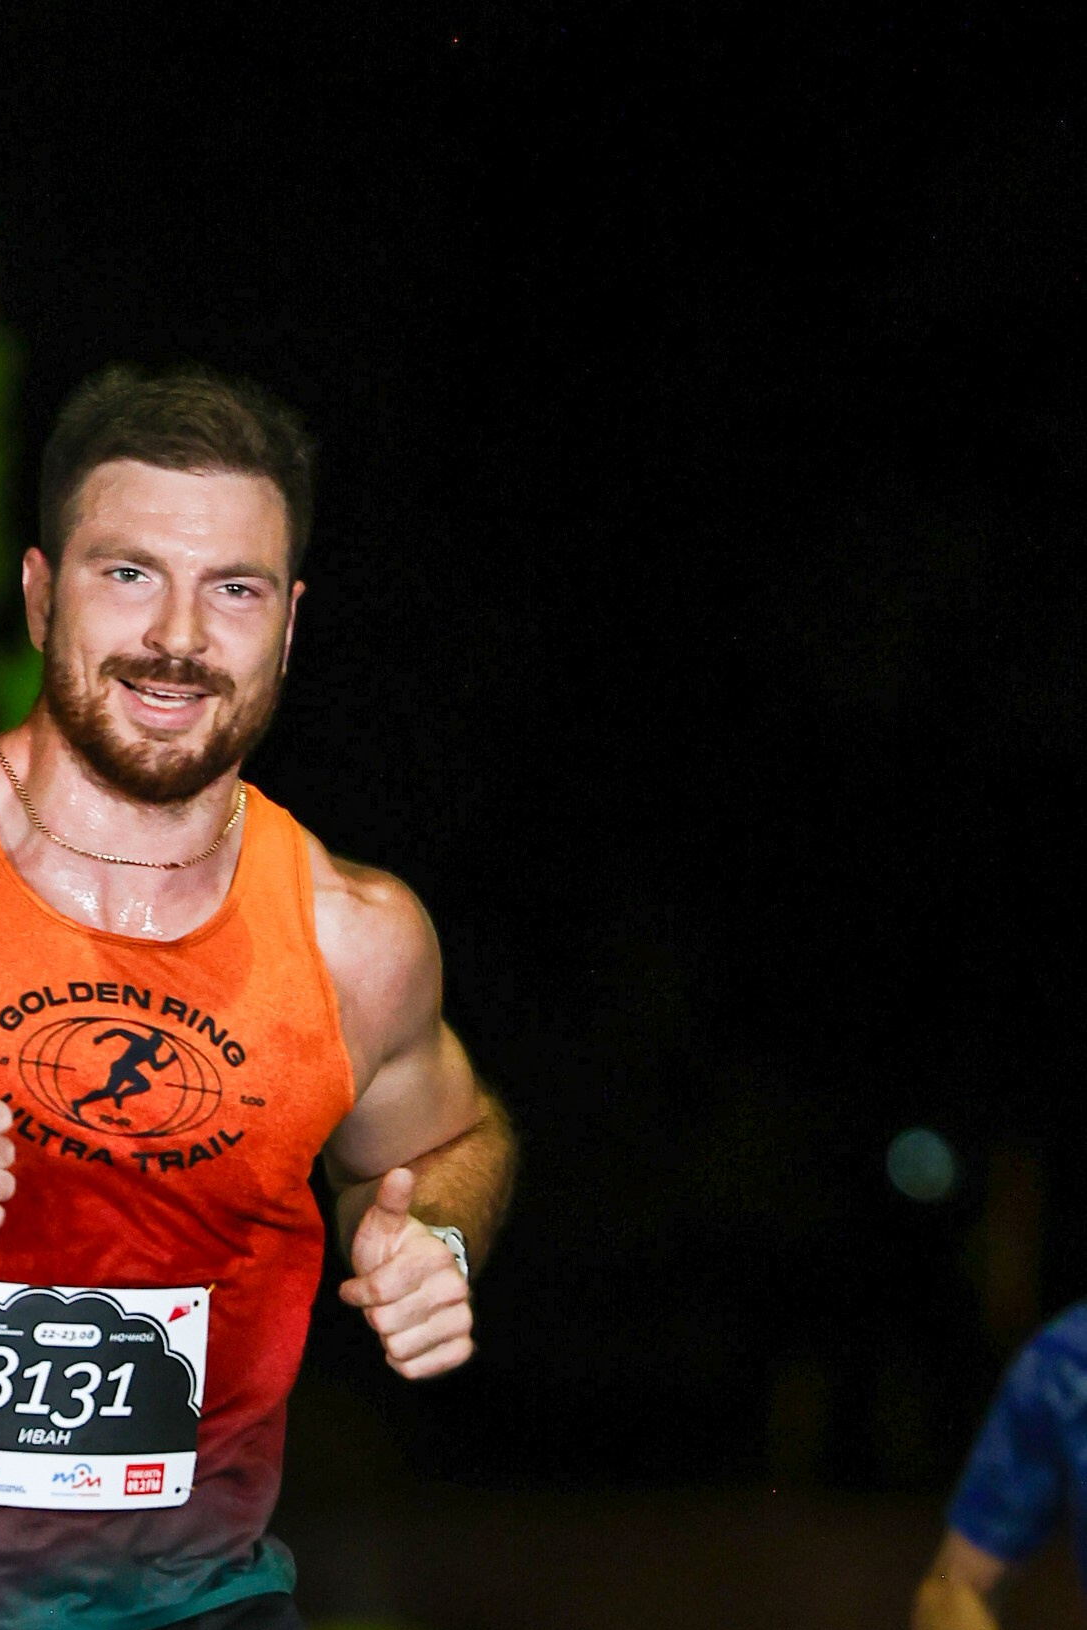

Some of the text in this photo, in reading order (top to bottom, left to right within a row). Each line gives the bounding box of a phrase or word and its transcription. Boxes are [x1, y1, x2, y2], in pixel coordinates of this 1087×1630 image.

[161, 996, 246, 1067] RING
[131, 1129, 245, 1174] TRAIL
[17, 1427, 72, 1446] ИВАН
